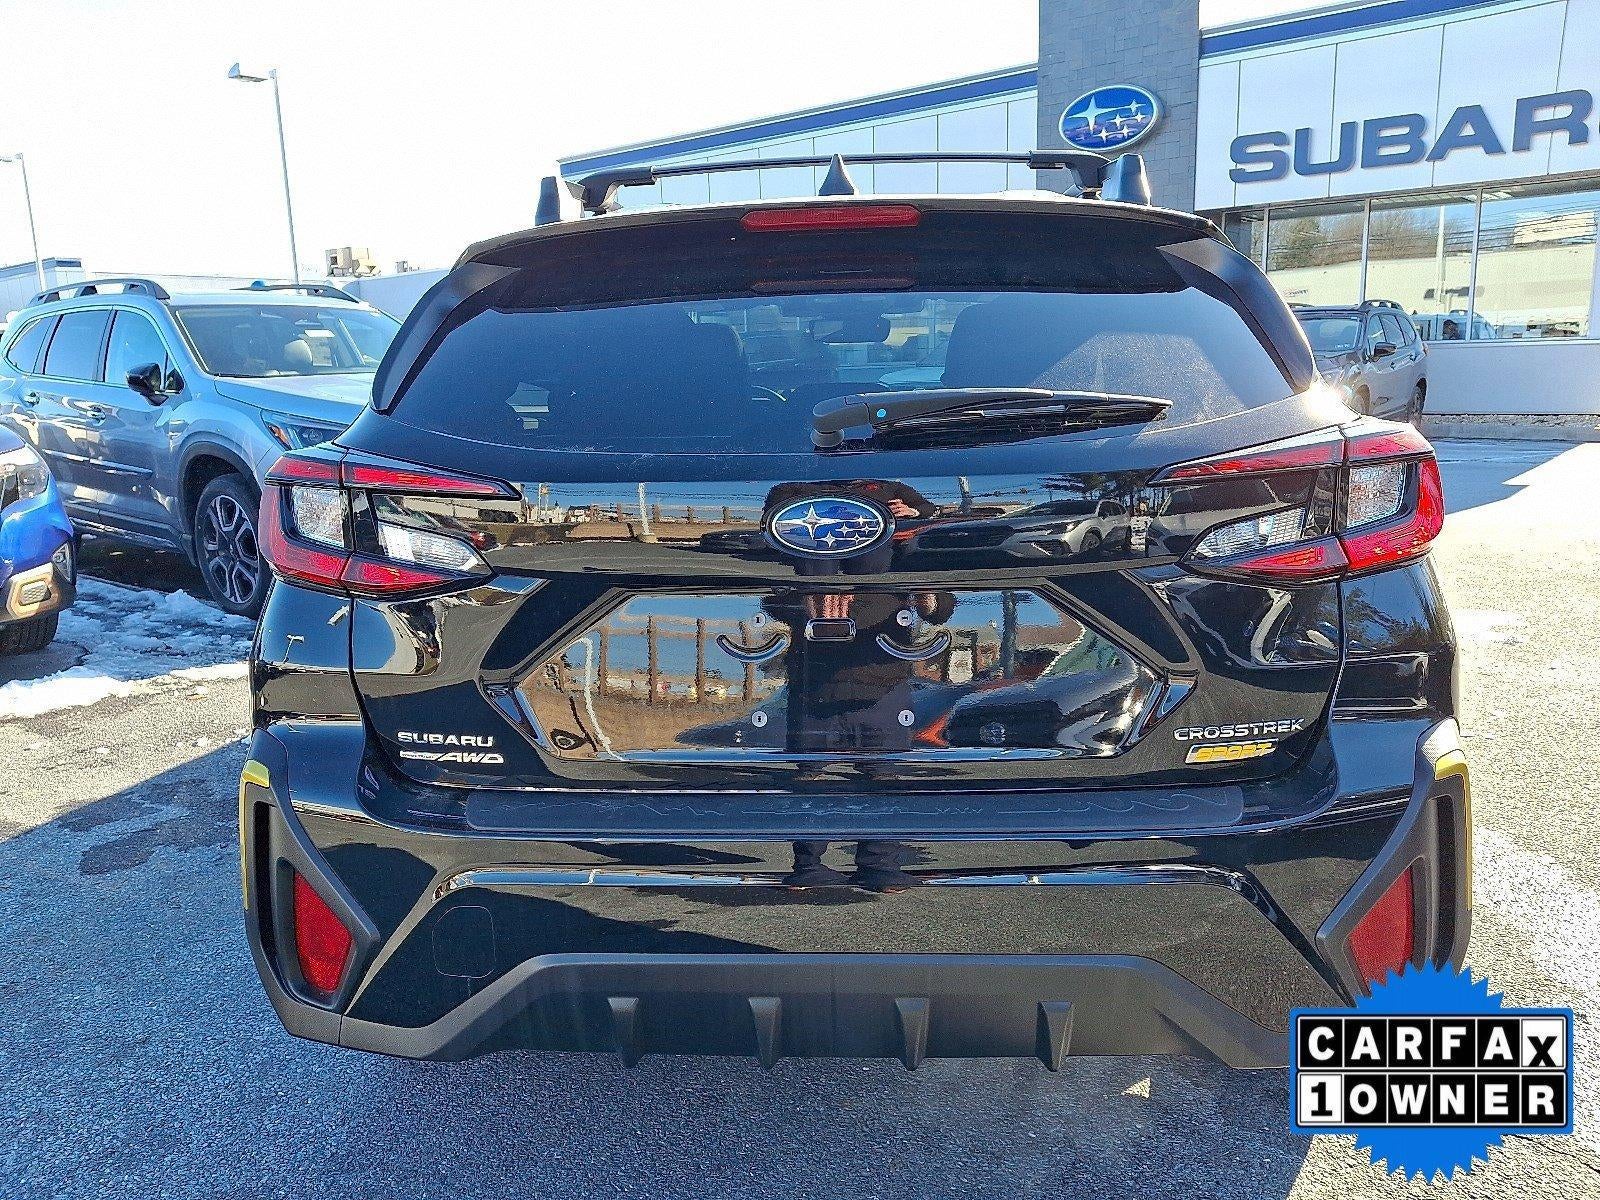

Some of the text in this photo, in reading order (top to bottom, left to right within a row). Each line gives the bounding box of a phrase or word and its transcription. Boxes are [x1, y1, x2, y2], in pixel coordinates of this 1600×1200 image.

[1229, 89, 1600, 184] SUBAR
[1173, 719, 1304, 740] CROSSTREK
[398, 731, 493, 747] SUBARU
[437, 752, 505, 764] AWD
[1195, 743, 1272, 759] SPORT
